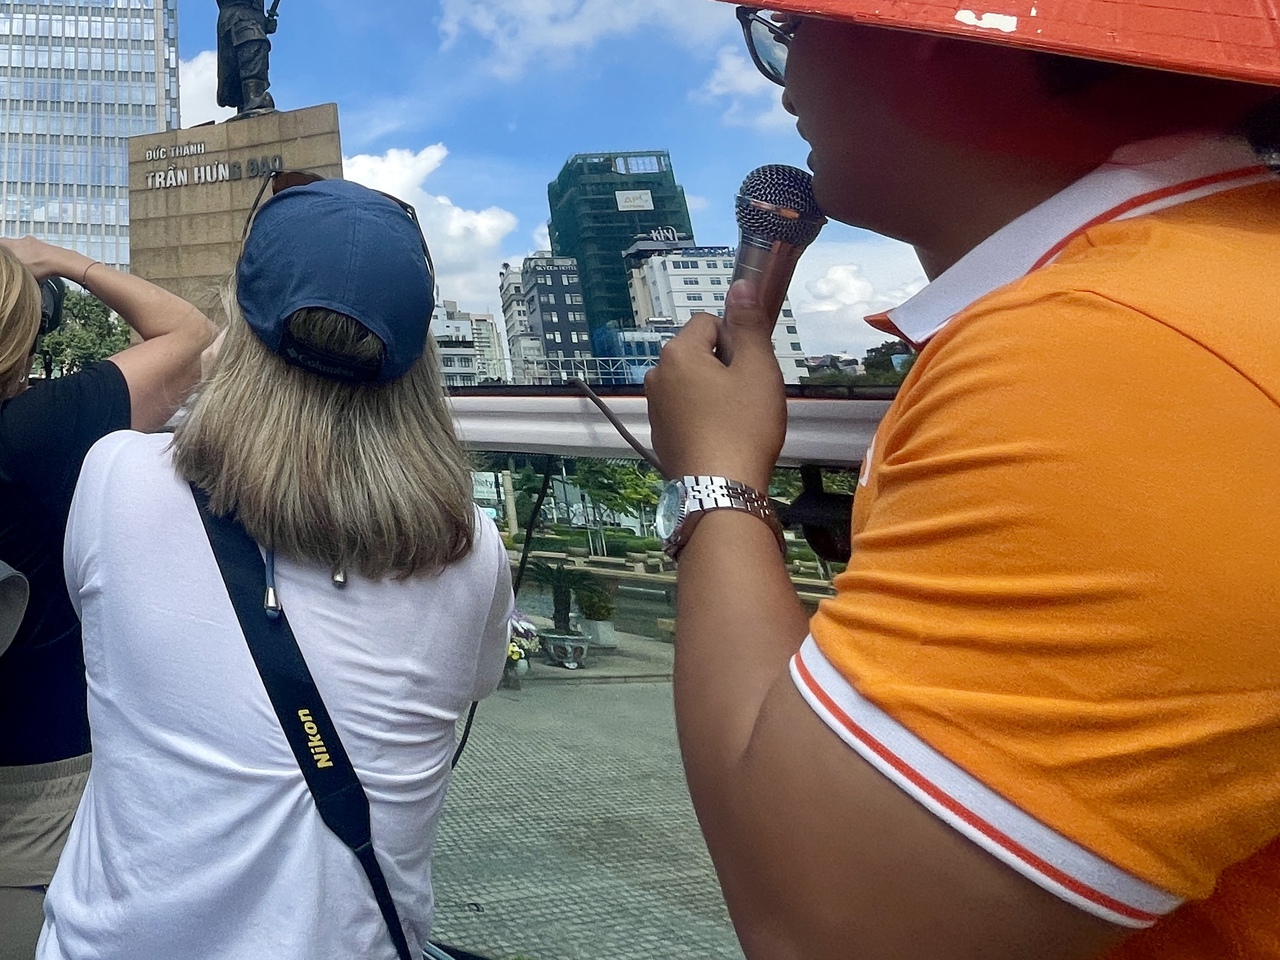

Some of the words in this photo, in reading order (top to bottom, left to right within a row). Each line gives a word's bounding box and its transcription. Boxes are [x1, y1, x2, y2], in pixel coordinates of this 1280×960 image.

[146, 145, 167, 161] ĐỨC
[171, 141, 205, 157] THÁNH
[146, 163, 188, 189] TRẦN
[194, 160, 242, 184] HƯNG
[297, 708, 334, 769] Nikon
